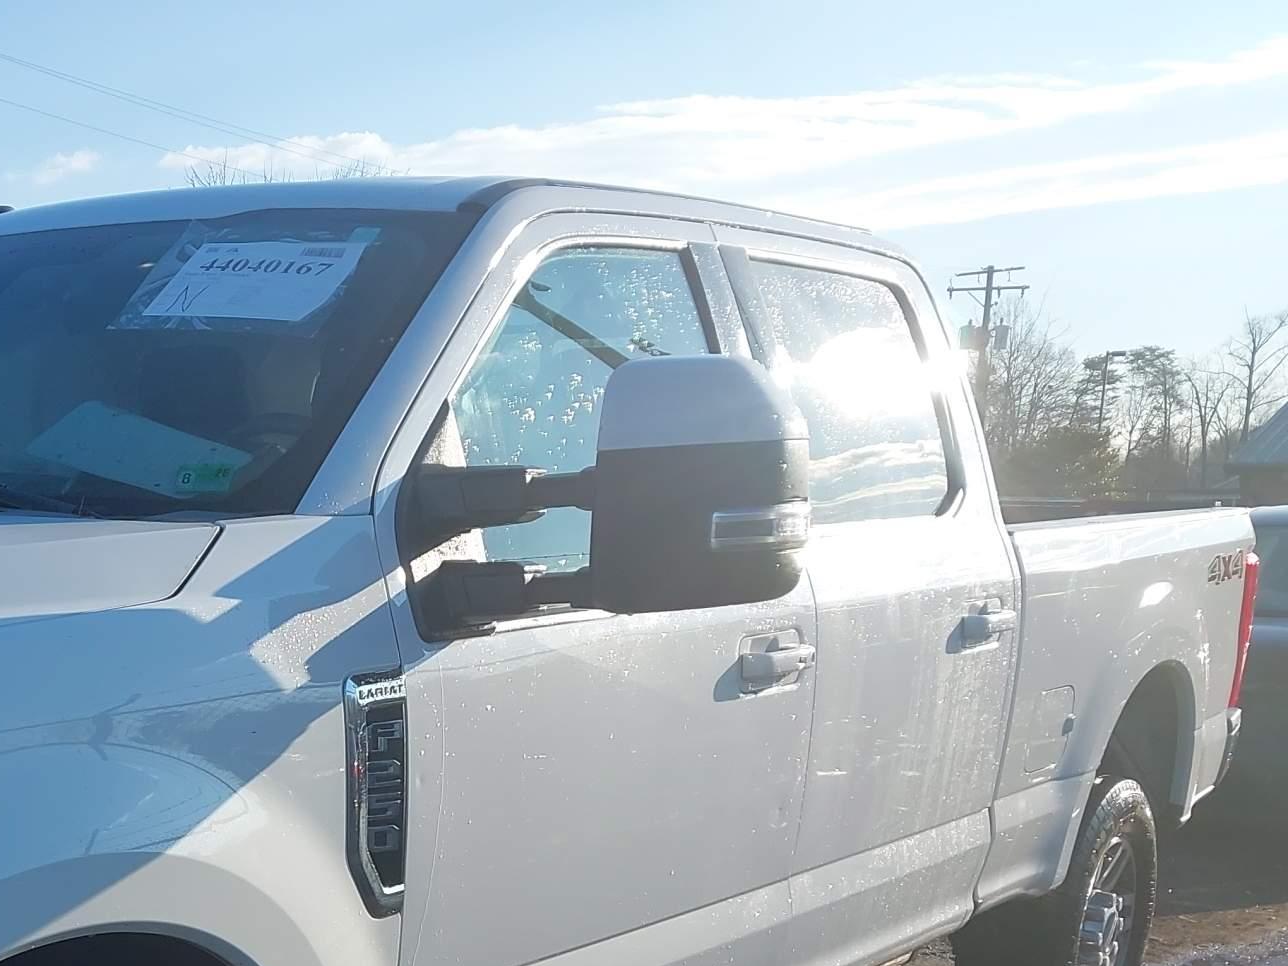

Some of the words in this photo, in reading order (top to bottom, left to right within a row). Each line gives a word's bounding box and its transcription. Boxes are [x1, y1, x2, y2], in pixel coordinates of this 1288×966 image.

[200, 257, 336, 278] 44040167
[181, 472, 193, 485] 8
[358, 683, 405, 701] LARIAT
